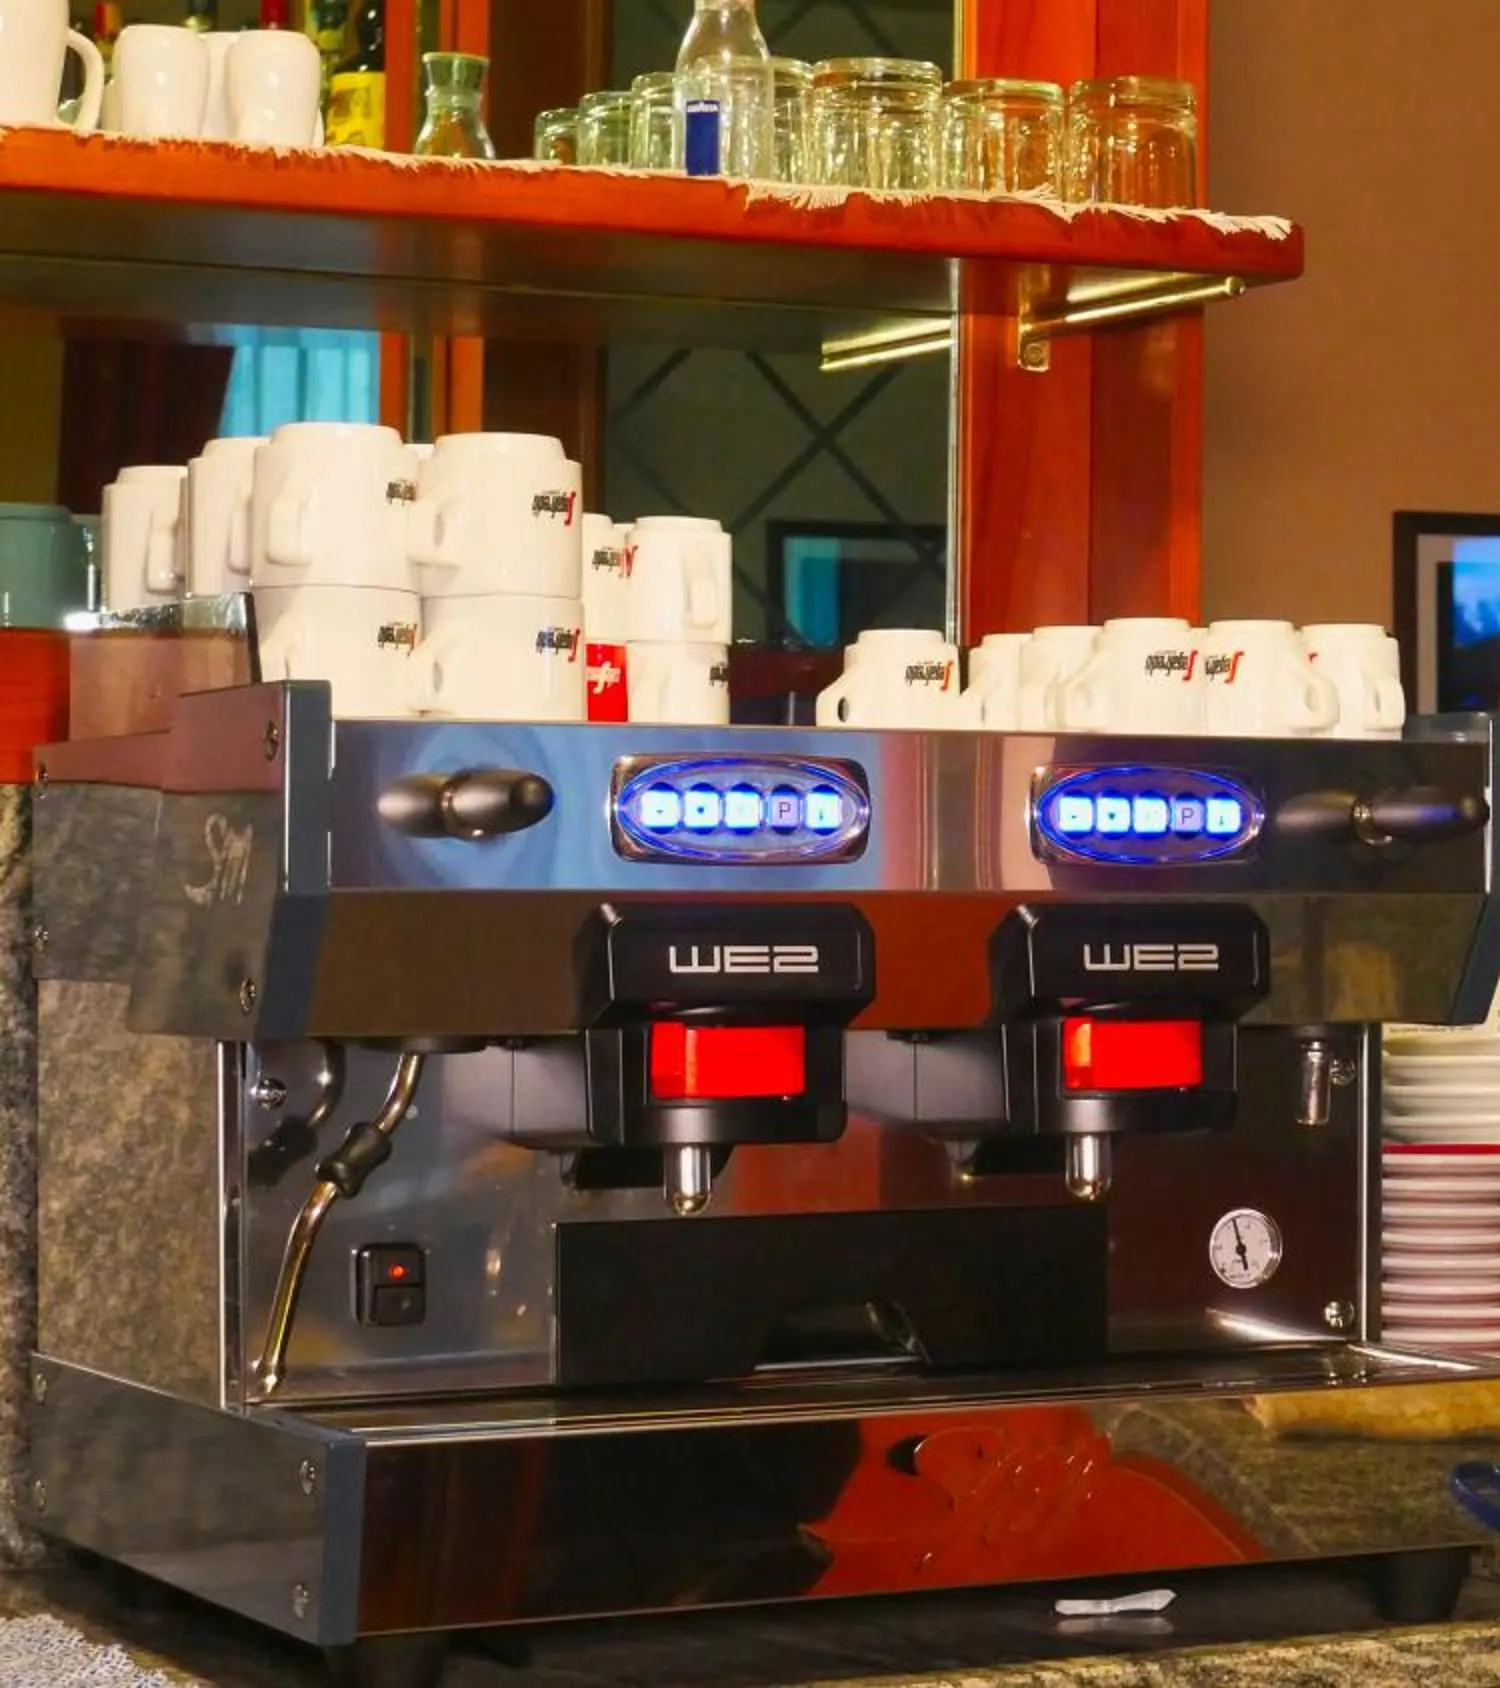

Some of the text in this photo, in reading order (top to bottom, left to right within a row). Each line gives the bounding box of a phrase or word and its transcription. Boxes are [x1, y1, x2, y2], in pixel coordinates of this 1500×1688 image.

[779, 801, 792, 819] P
[1181, 807, 1195, 824] P
[669, 945, 819, 973] WE2
[1083, 943, 1219, 971] WE2
